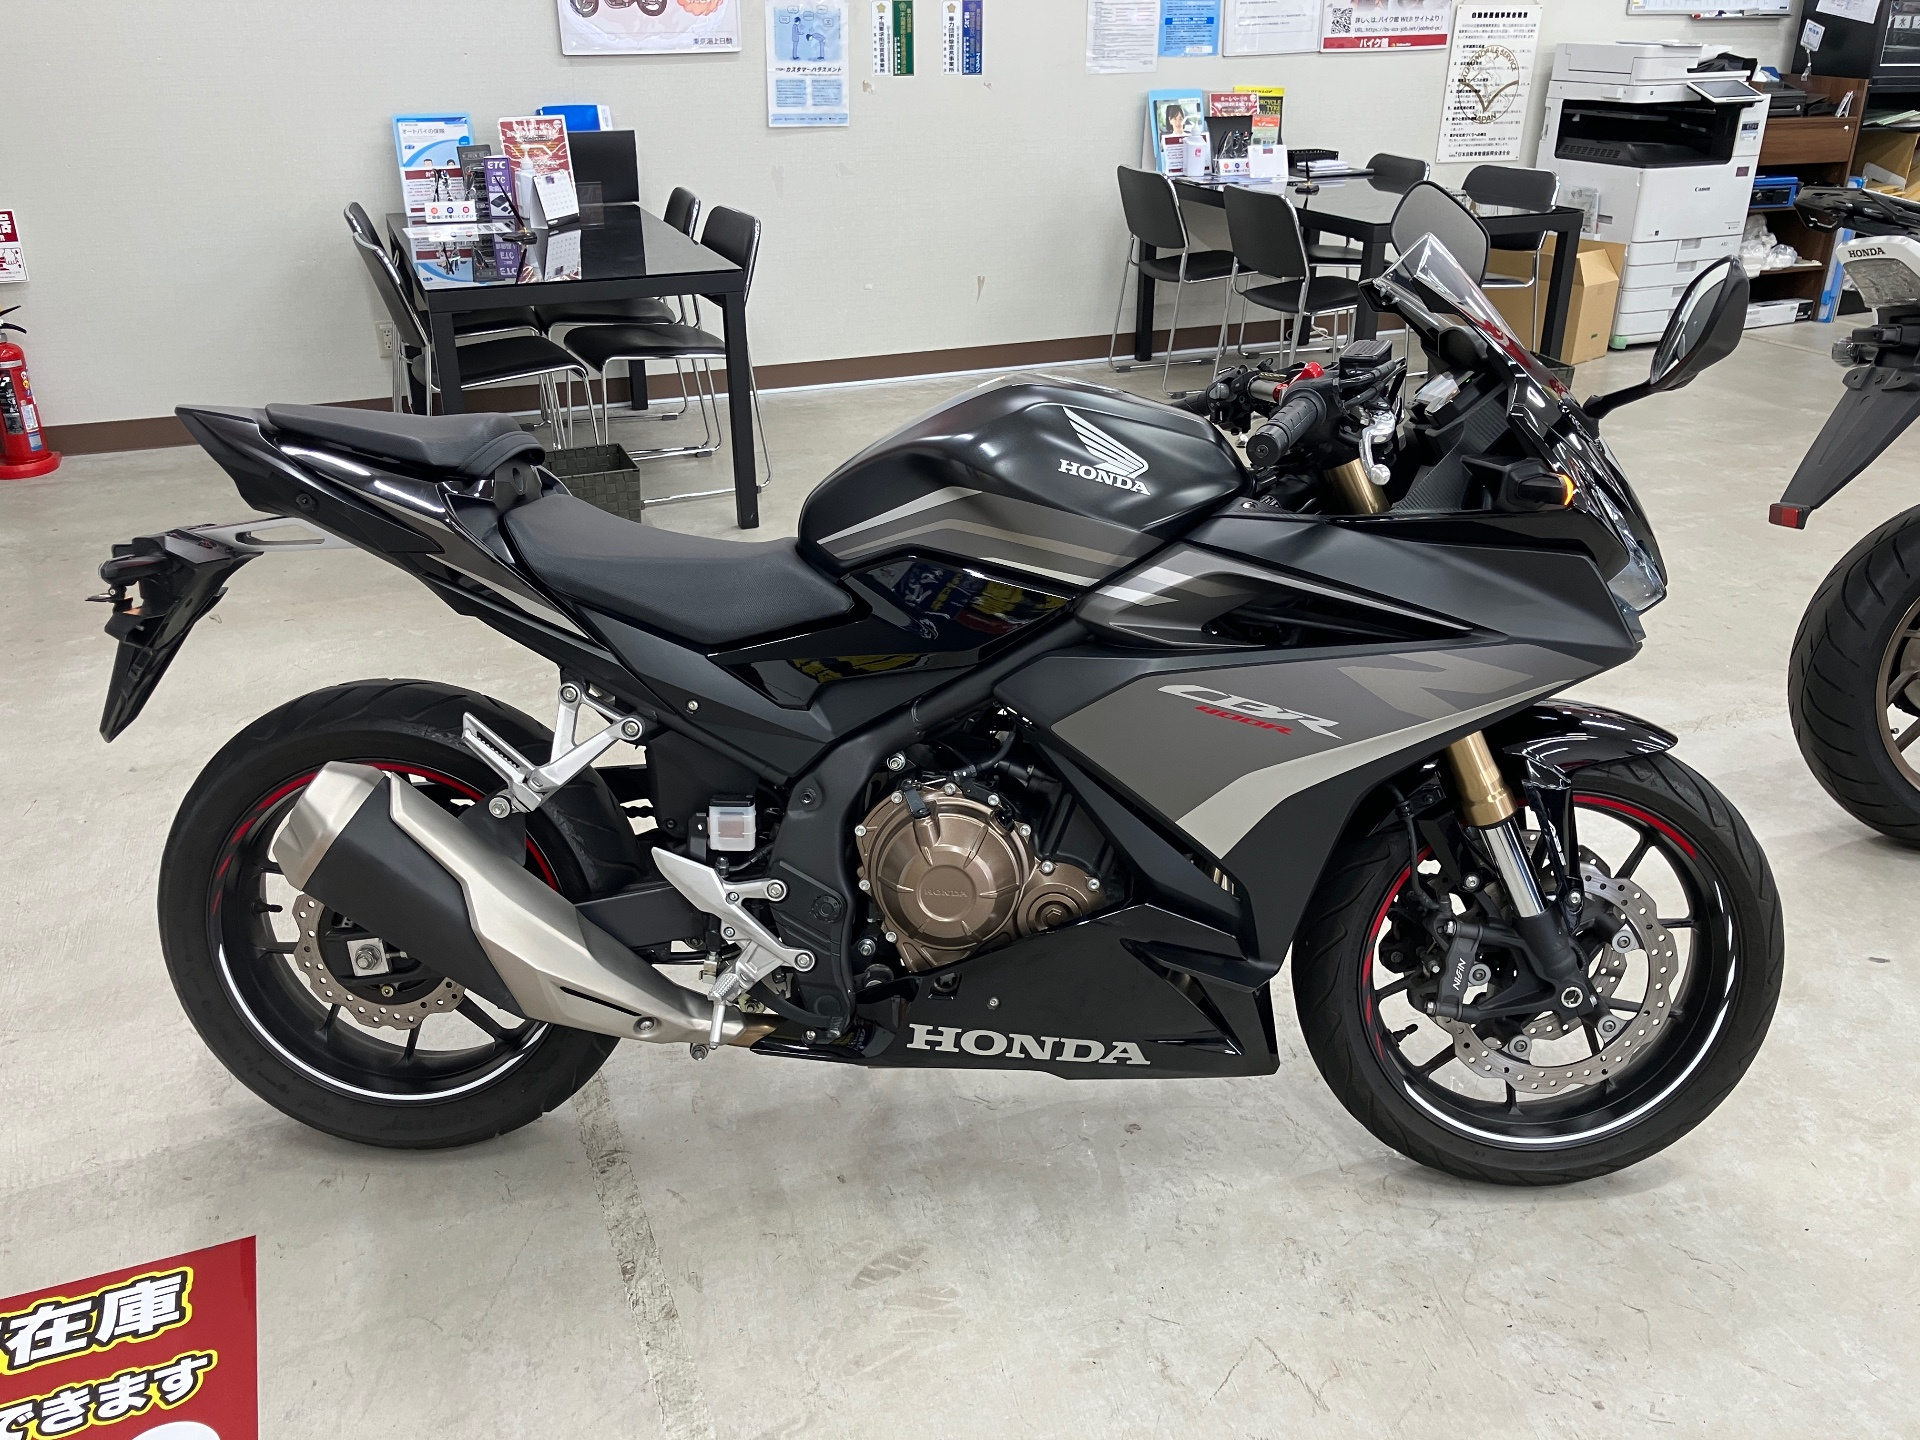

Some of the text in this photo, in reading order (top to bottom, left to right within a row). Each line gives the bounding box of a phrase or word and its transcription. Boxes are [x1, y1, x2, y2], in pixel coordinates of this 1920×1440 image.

[1473, 112, 1497, 123] JAPAN
[487, 160, 506, 169] ETC
[491, 176, 506, 184] ETC
[1848, 247, 1886, 258] HONDA
[1058, 459, 1151, 496] HONDA
[1157, 684, 1343, 740] CBR
[1194, 705, 1294, 736] 400R
[924, 888, 968, 898] HONDA
[1452, 957, 1467, 991] NISSIN
[906, 1023, 1151, 1065] HONDA
[4, 1274, 183, 1367] 在庫
[0, 1356, 209, 1440] できます
